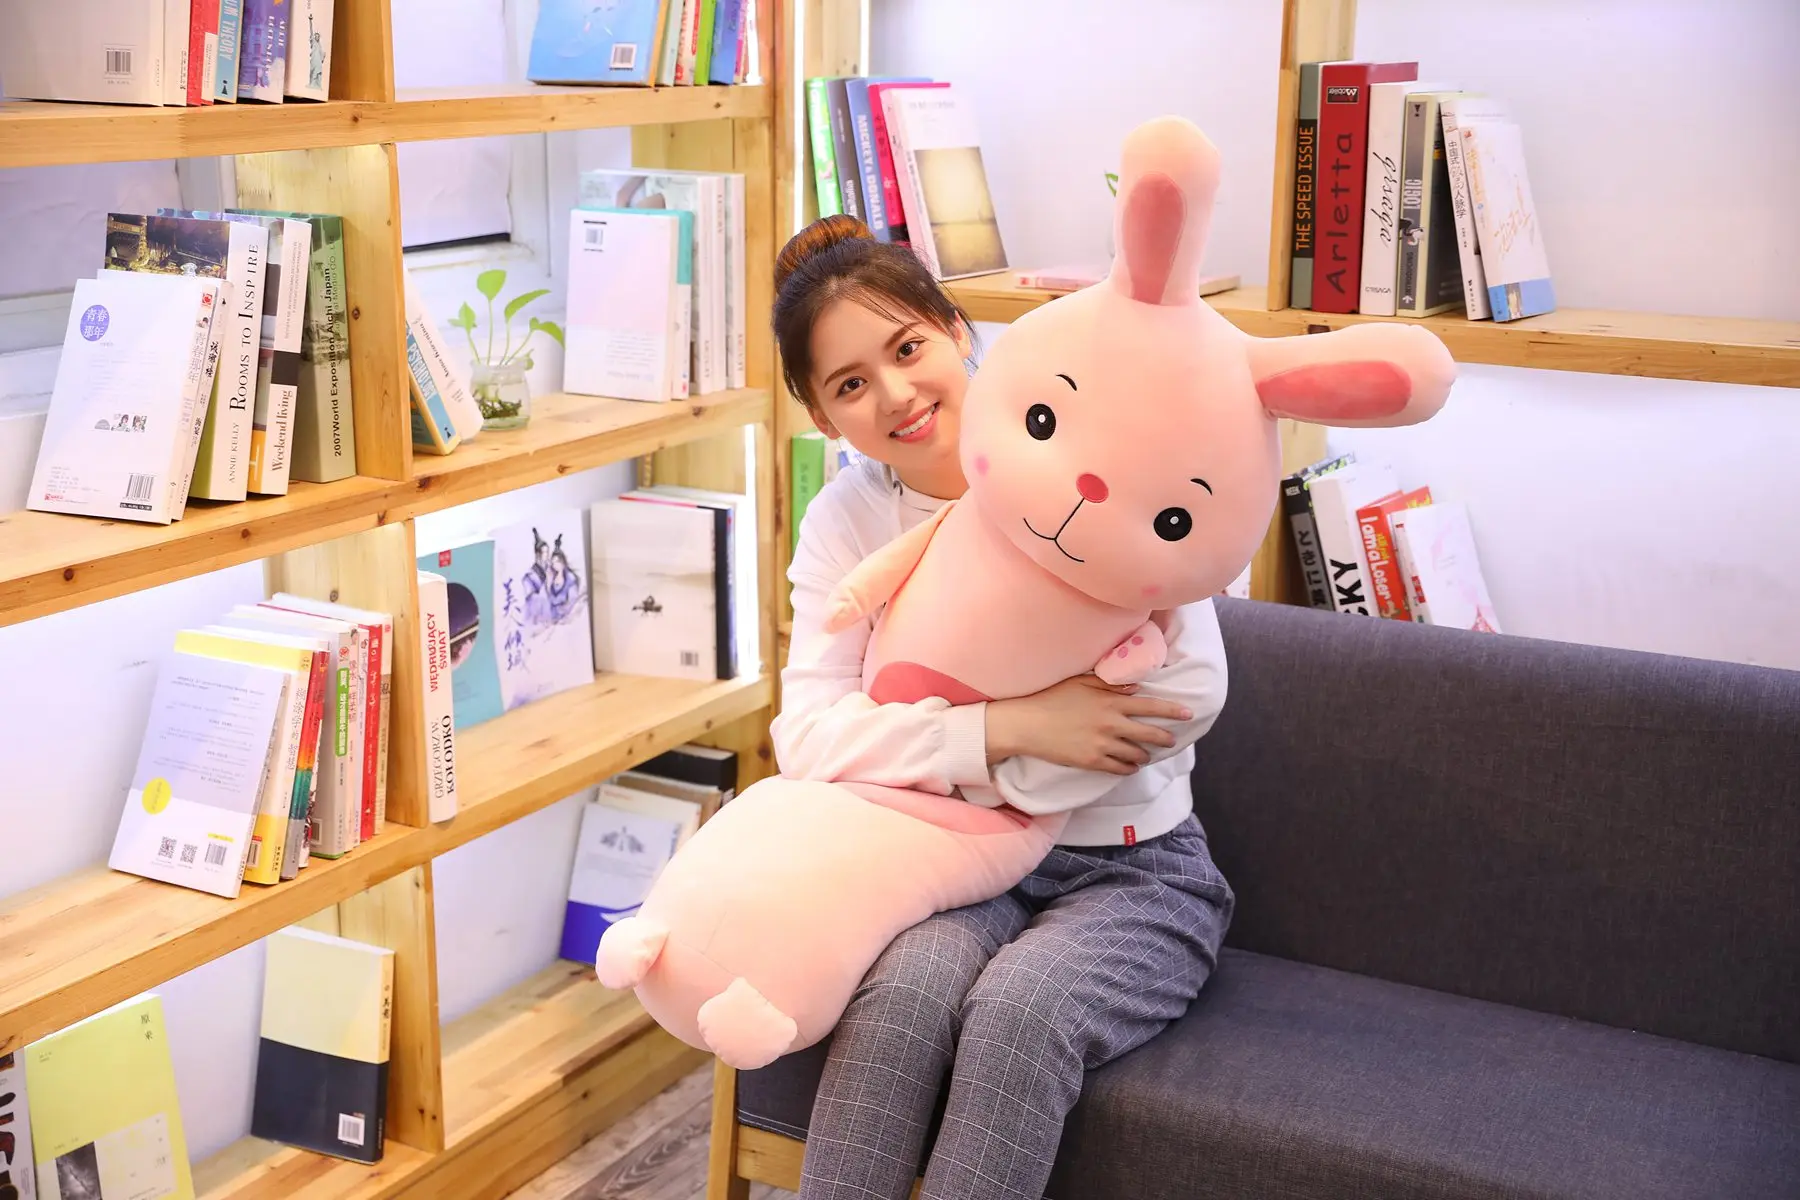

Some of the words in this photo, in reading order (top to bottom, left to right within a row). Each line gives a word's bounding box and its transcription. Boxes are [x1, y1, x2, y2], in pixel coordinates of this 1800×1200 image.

[219, 19, 237, 61] THEORY
[1299, 126, 1314, 171] ISSUE
[857, 114, 873, 167] MICKEY
[865, 176, 885, 231] DONALD
[1403, 178, 1422, 209] LOGIC
[1297, 173, 1313, 219] SPEED
[1326, 133, 1353, 294] Arletta
[1296, 222, 1311, 251] THE
[238, 243, 260, 320] INSPIRE
[323, 267, 332, 302] Japan
[242, 327, 252, 347] TO
[325, 301, 335, 331] Aichi
[229, 353, 251, 412] ROOMS
[327, 331, 339, 396] Exposition
[277, 389, 293, 419] living
[271, 419, 287, 472] Weekend
[437, 628, 448, 671] ŚWIAT
